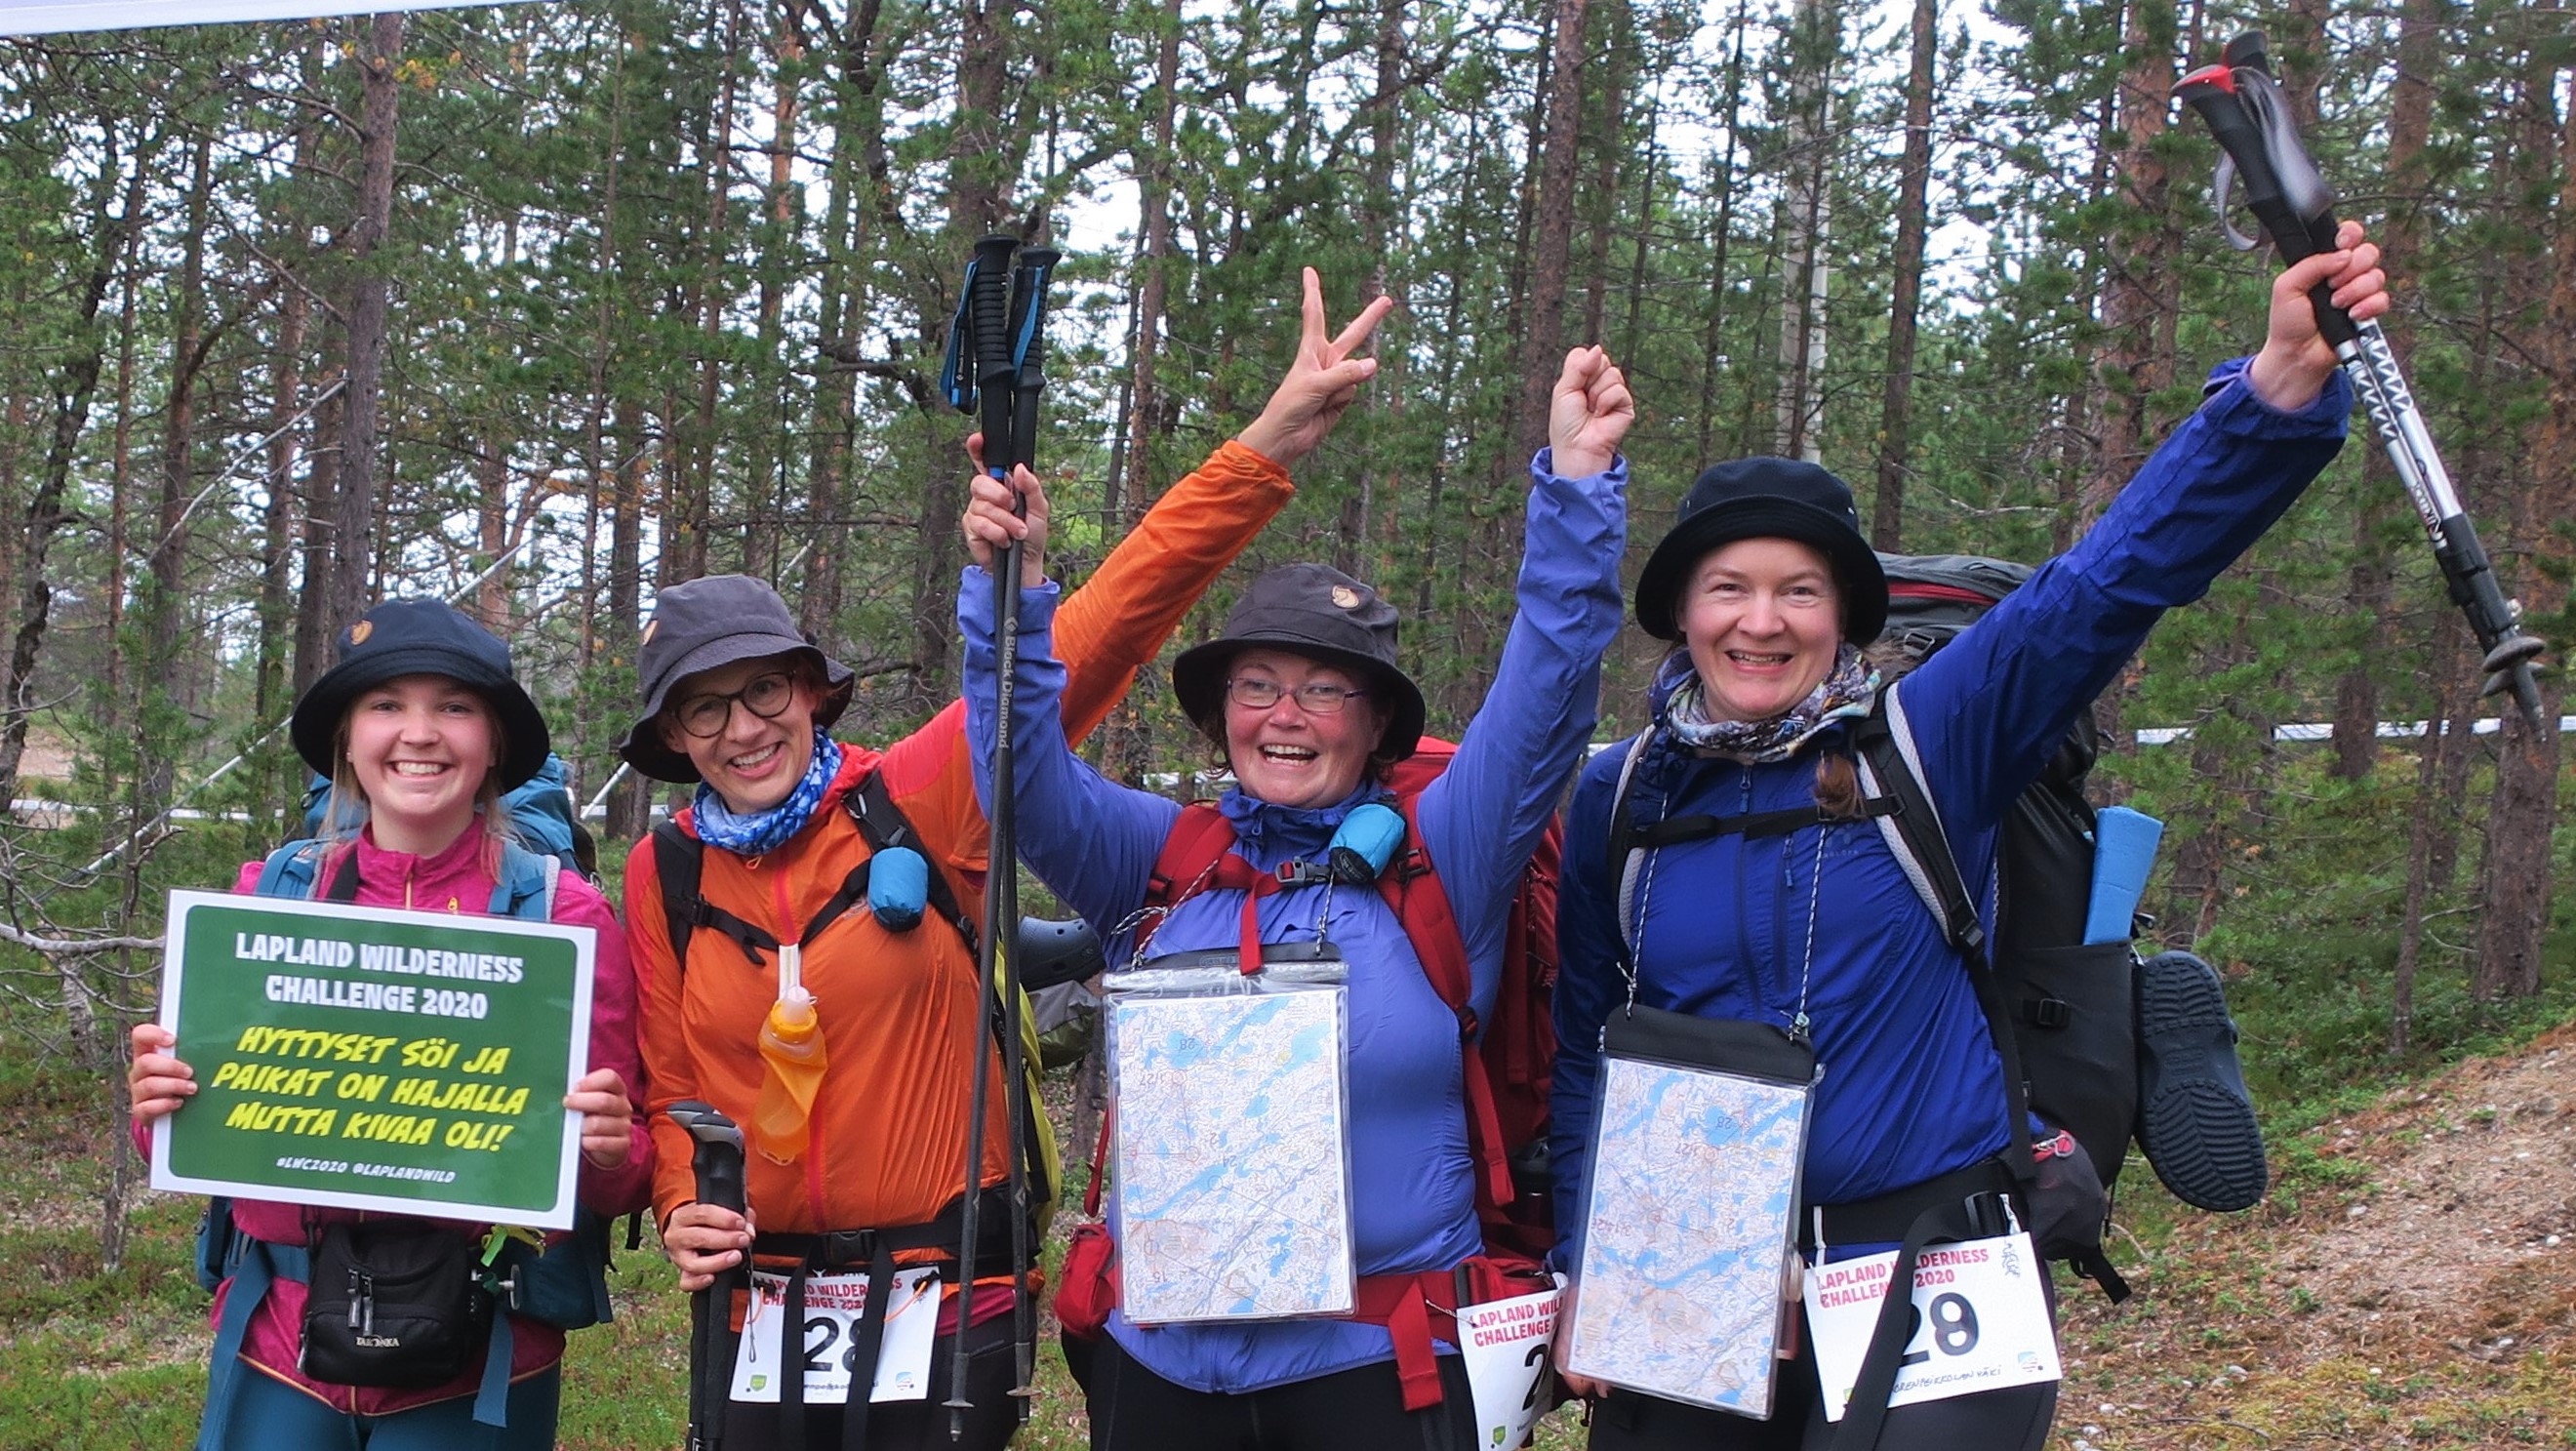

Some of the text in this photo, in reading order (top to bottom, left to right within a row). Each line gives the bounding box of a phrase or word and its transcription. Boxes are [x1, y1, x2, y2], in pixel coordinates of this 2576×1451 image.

[998, 636, 1016, 748] Black Diamond
[235, 933, 524, 984] LAPLAND WILDERNESS
[265, 976, 488, 1020] CHALLENGE 2020
[236, 1027, 510, 1074] HYTTYSET SÖI JA
[211, 1062, 530, 1115] PAIKAT ON HAJALLA
[225, 1102, 513, 1151] MUTTA KIVAA OLI!
[276, 1157, 456, 1183] #LWC2020 @LAPLANDWILD
[817, 1277, 903, 1297] WILDERS
[1816, 1263, 1887, 1291] LAPLAND
[1820, 1269, 1955, 1309] CHALLEN 2020
[1470, 1305, 1534, 1329] LAPLAND
[1474, 1319, 1550, 1347] CHALLENGE
[1899, 1292, 1980, 1367] 28
